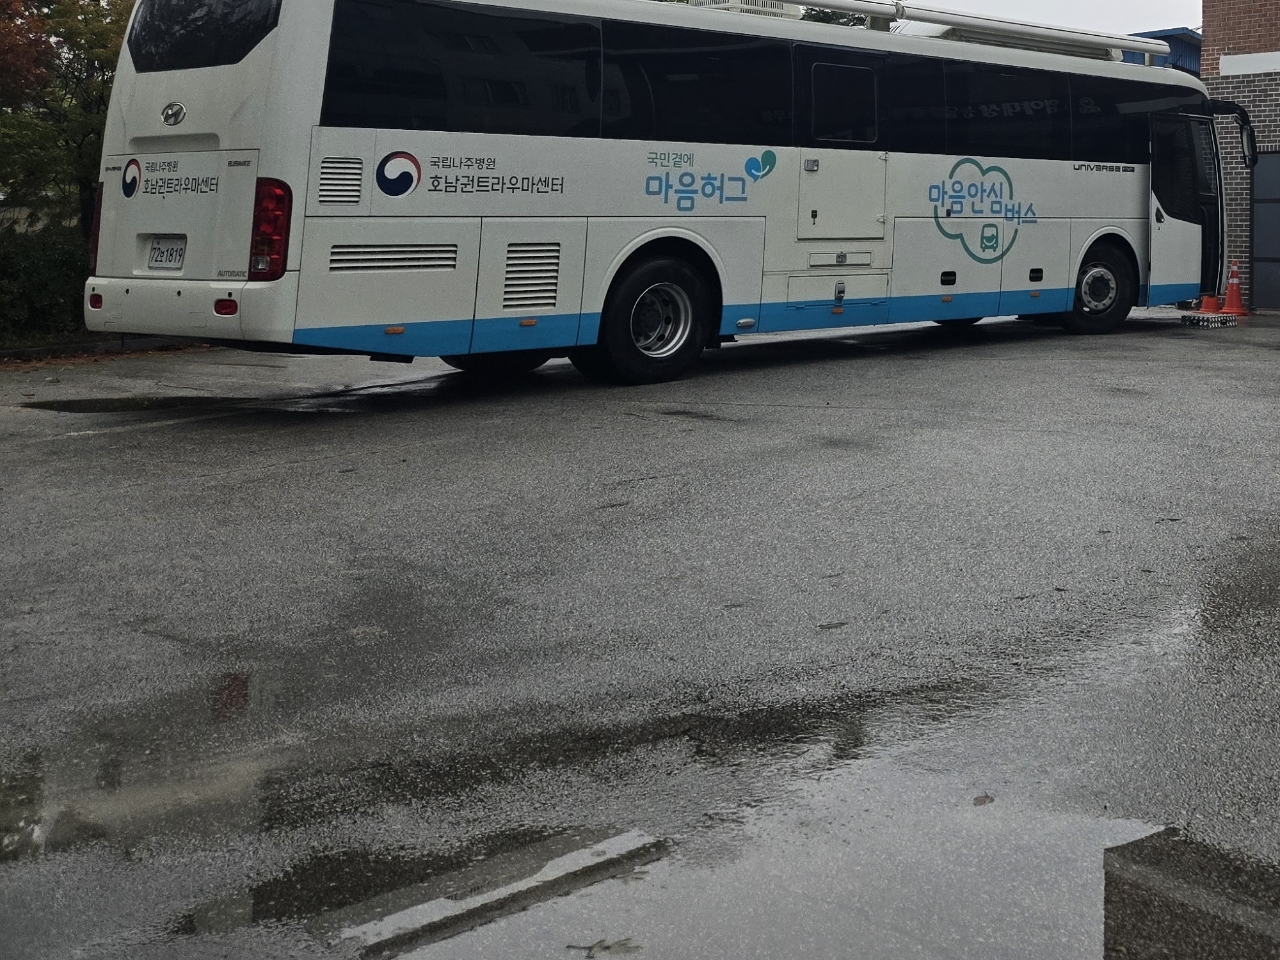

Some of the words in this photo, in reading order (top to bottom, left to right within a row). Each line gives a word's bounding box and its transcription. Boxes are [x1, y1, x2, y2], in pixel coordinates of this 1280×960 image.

[145, 160, 179, 173] 국립나주병원
[429, 156, 496, 170] 국립나주병원
[646, 151, 695, 168] 국민곁에
[1073, 164, 1121, 173] UNIVERSE
[142, 176, 219, 195] 호남권트라우마센터
[427, 174, 565, 194] 호남권트라우마센터
[645, 171, 748, 212] 마음허그
[928, 179, 1004, 215] 마음안심
[1004, 201, 1038, 226] 버스
[217, 270, 247, 278] AUTOMATIC
